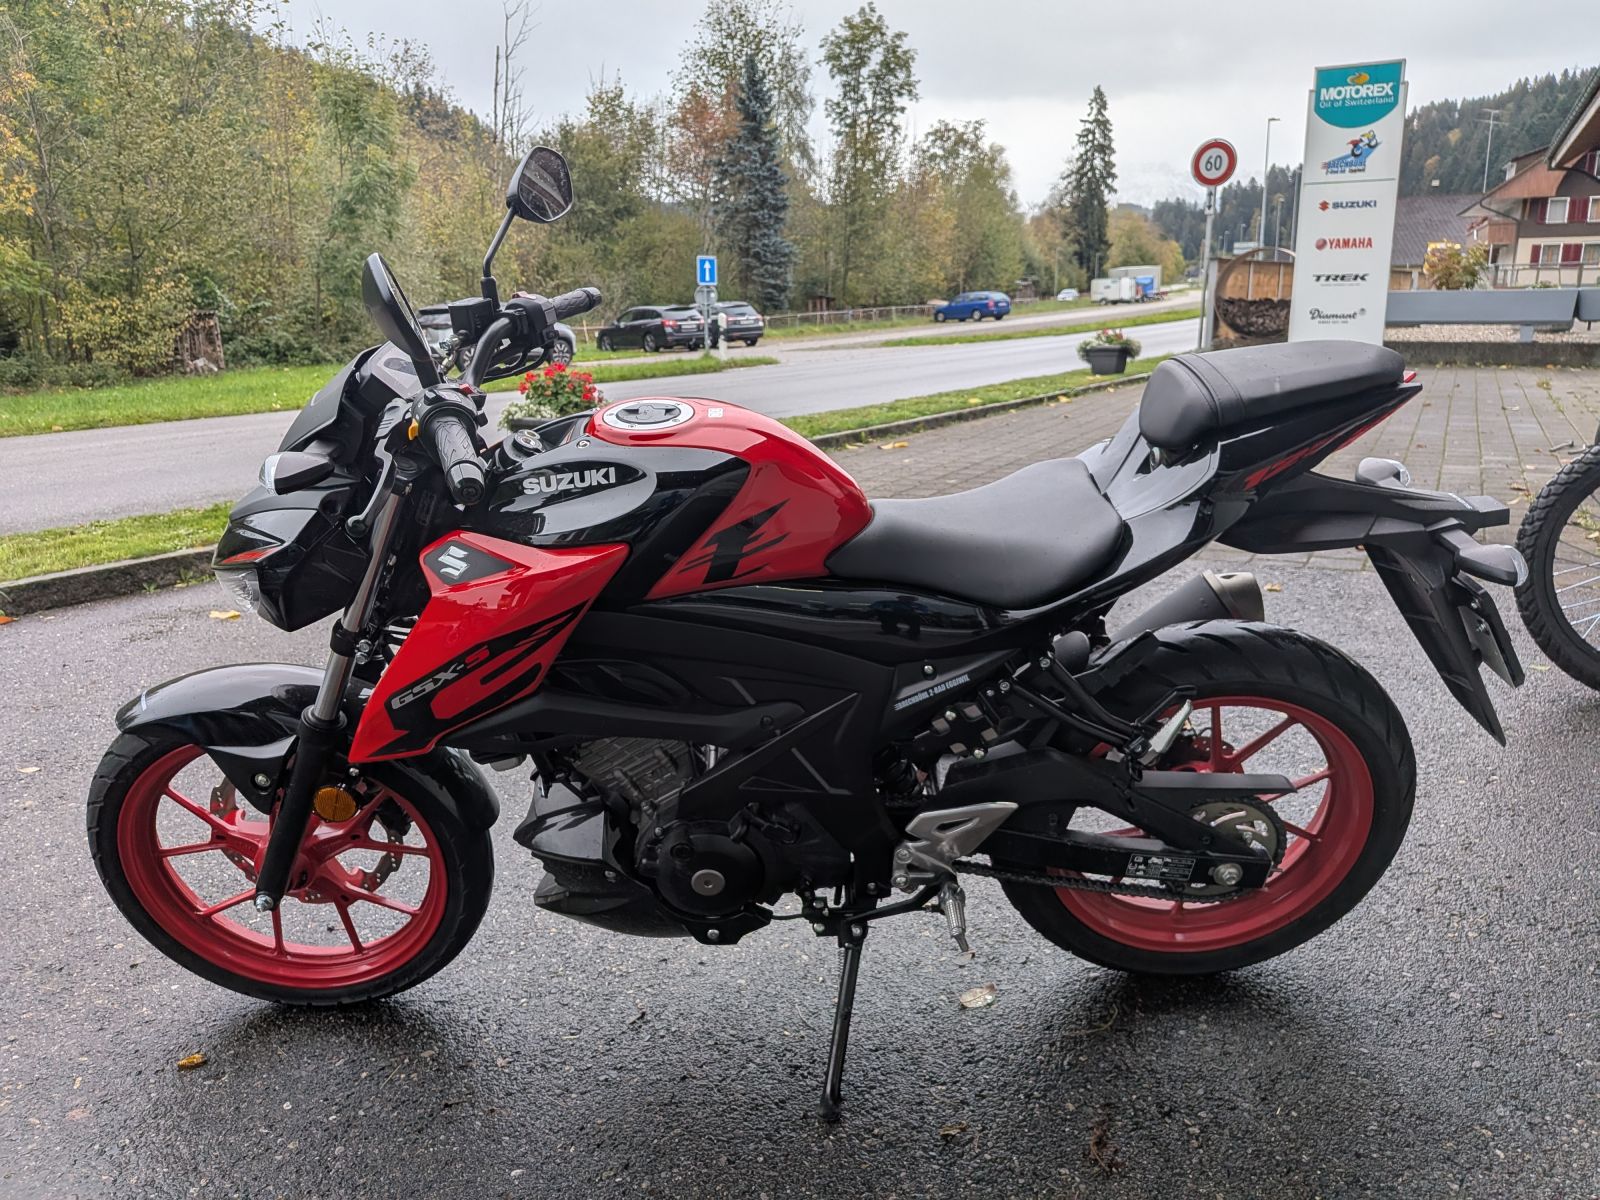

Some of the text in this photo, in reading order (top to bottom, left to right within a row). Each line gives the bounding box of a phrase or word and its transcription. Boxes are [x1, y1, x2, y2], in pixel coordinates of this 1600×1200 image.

[1320, 82, 1394, 100] MOTOREX
[1319, 96, 1394, 109] Oil of Switzerland
[1205, 154, 1223, 172] 60
[1332, 200, 1377, 209] SUZUKI
[1328, 237, 1373, 250] YAMAHA
[1312, 273, 1370, 282] TREK
[1309, 308, 1358, 320] Diamant
[522, 466, 616, 495] SUZUKI
